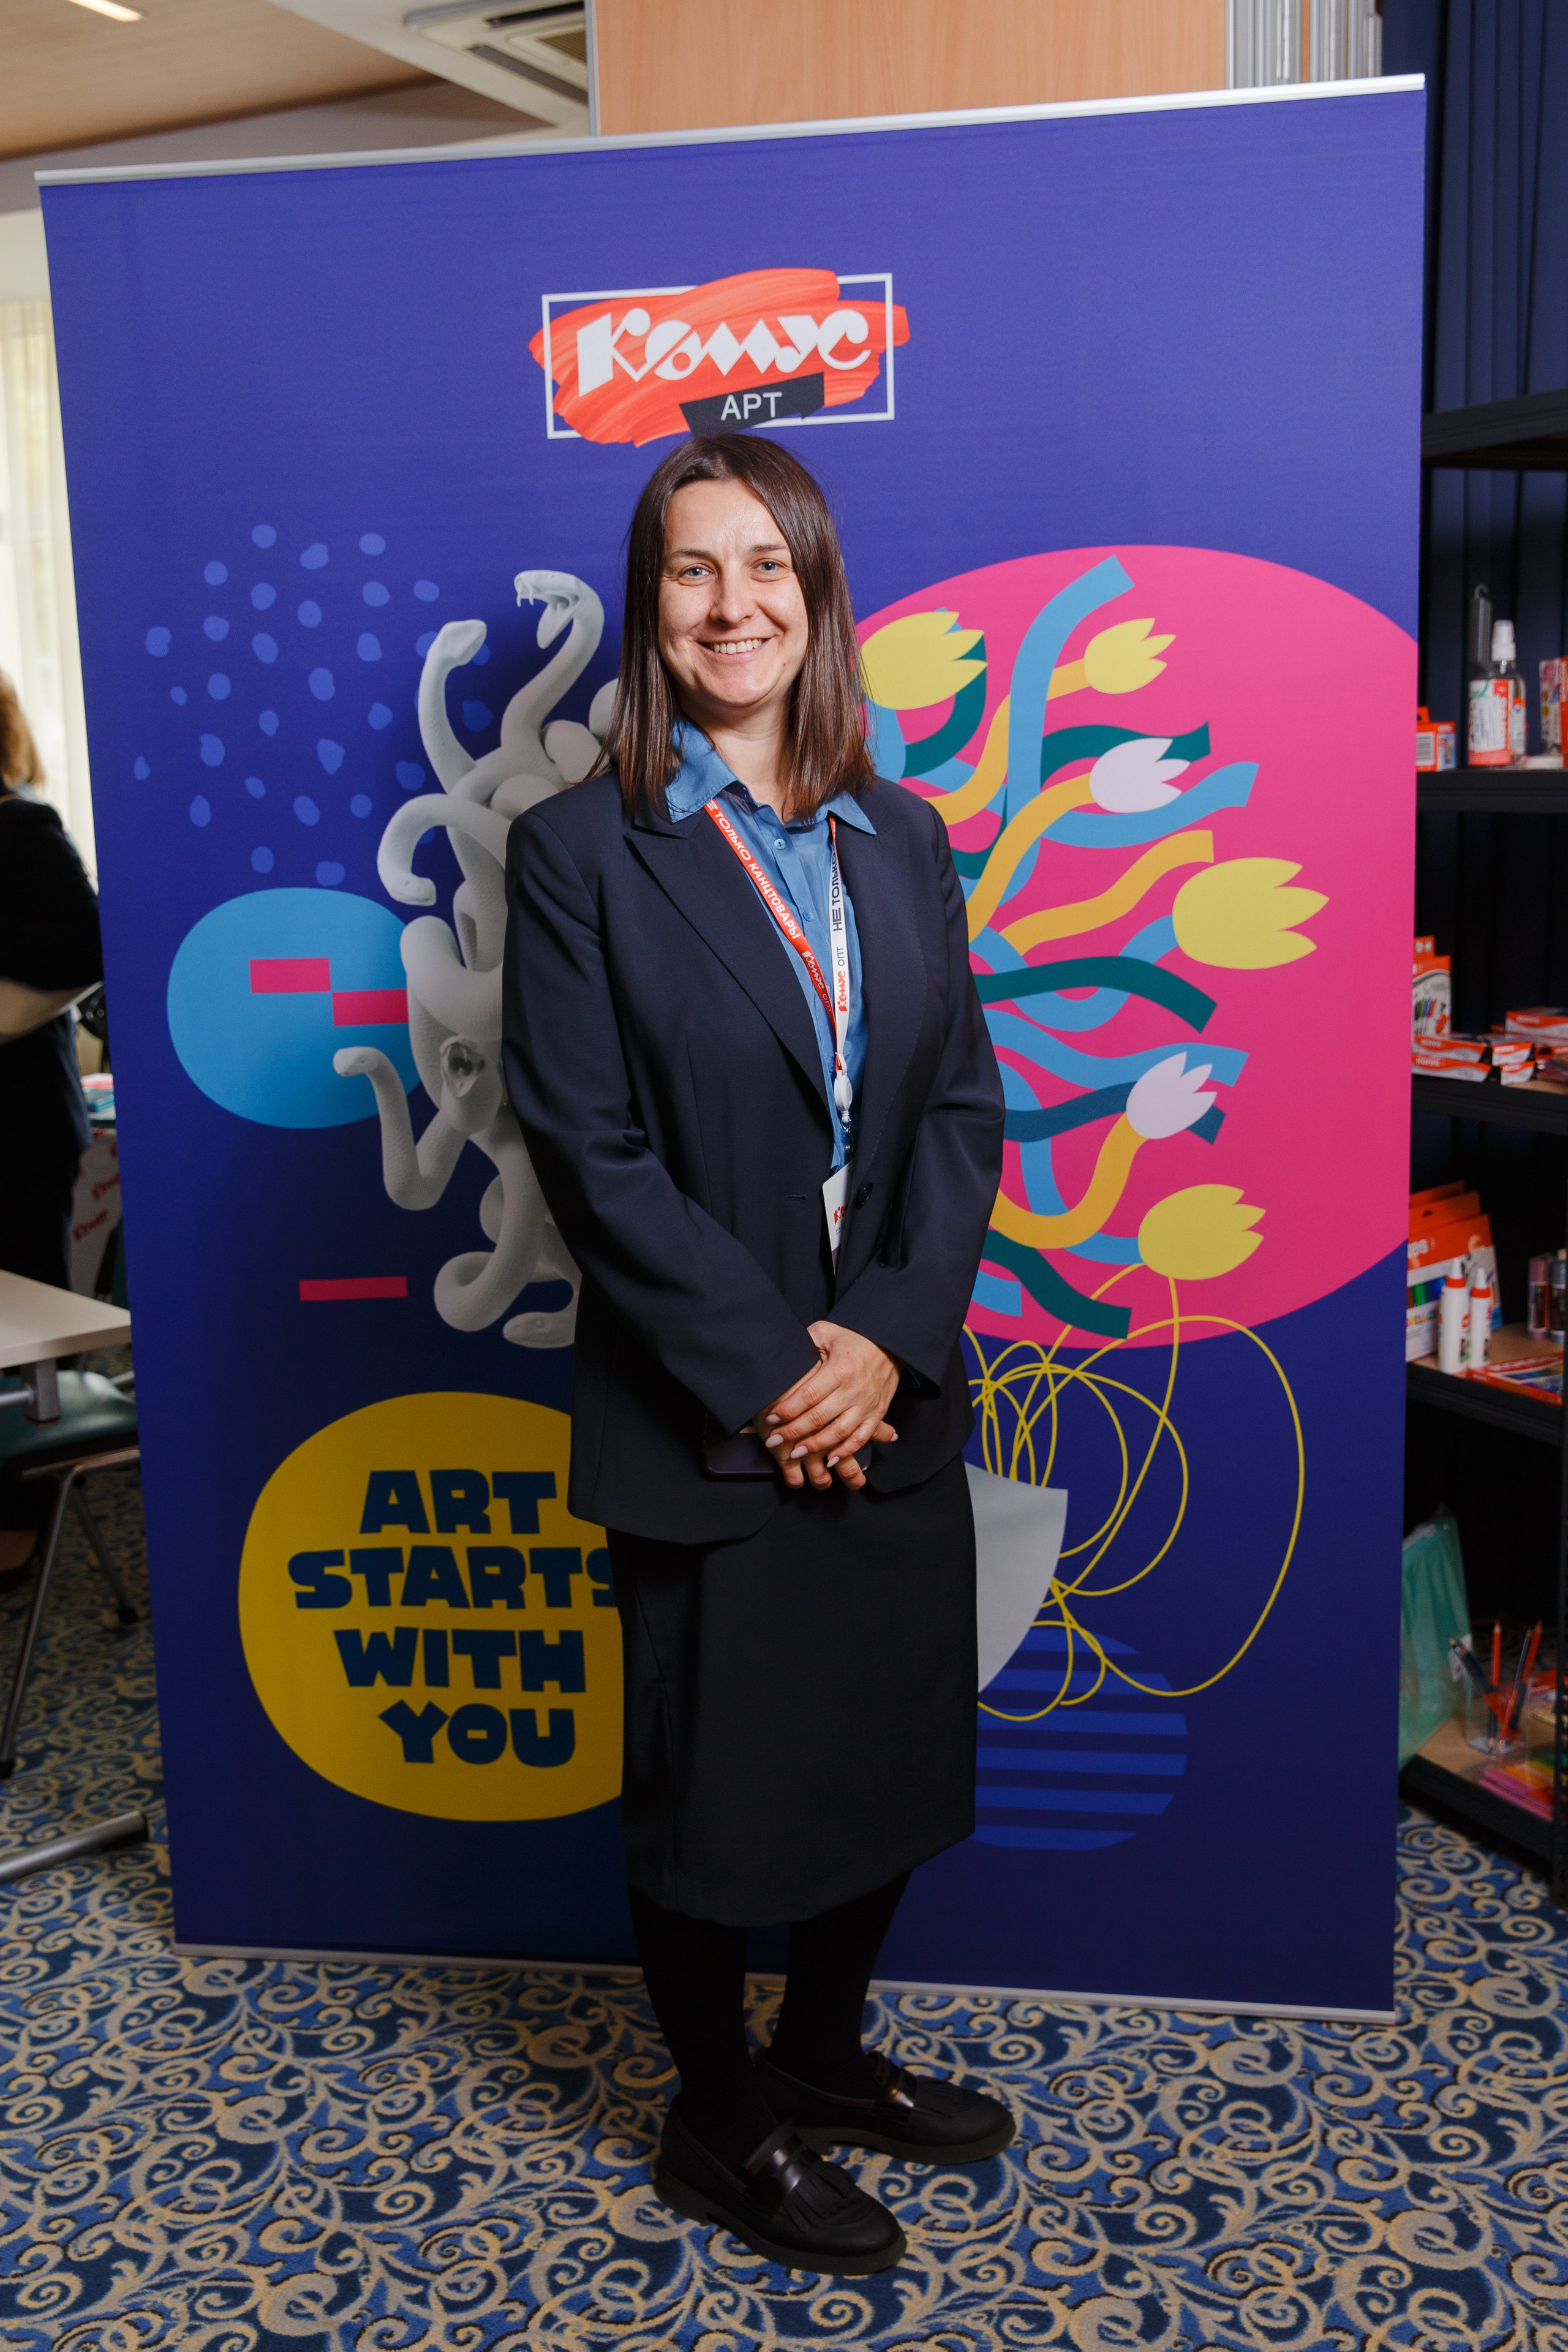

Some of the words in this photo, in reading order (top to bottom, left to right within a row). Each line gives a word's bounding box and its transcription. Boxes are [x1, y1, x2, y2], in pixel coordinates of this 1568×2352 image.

[721, 391, 782, 421] АРТ
[715, 811, 751, 861] ТОЛЬКО
[748, 862, 801, 940] КАНЦТОВАРЫ
[832, 907, 842, 932] НЕ
[359, 1468, 557, 1534] ART
[333, 1626, 586, 1693] WITH
[377, 1699, 576, 1768] YOU
